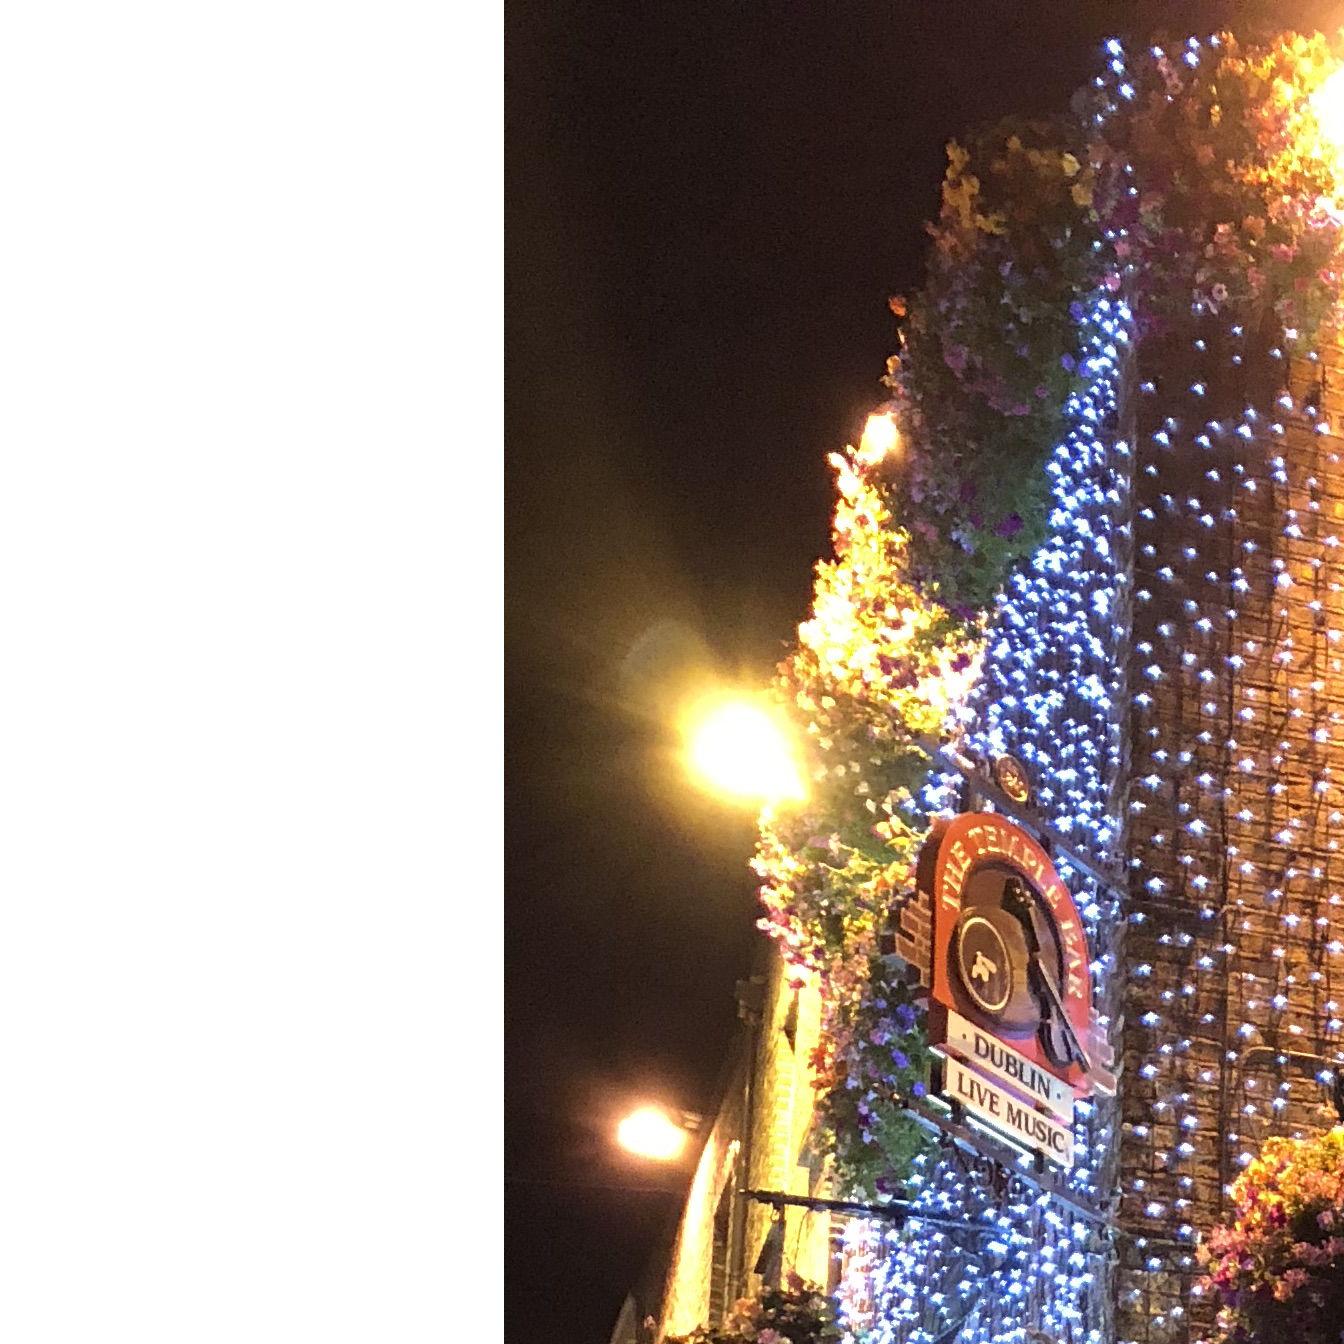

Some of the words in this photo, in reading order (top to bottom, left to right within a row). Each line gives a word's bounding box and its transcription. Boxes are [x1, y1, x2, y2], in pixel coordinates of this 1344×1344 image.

[940, 842, 971, 910] THE
[968, 824, 1061, 911] TEMPLE
[1060, 917, 1083, 999] BAR
[974, 1033, 1051, 1100] DUBLIN
[957, 1070, 1001, 1114] LIVE
[1006, 1101, 1066, 1153] MUSIC
